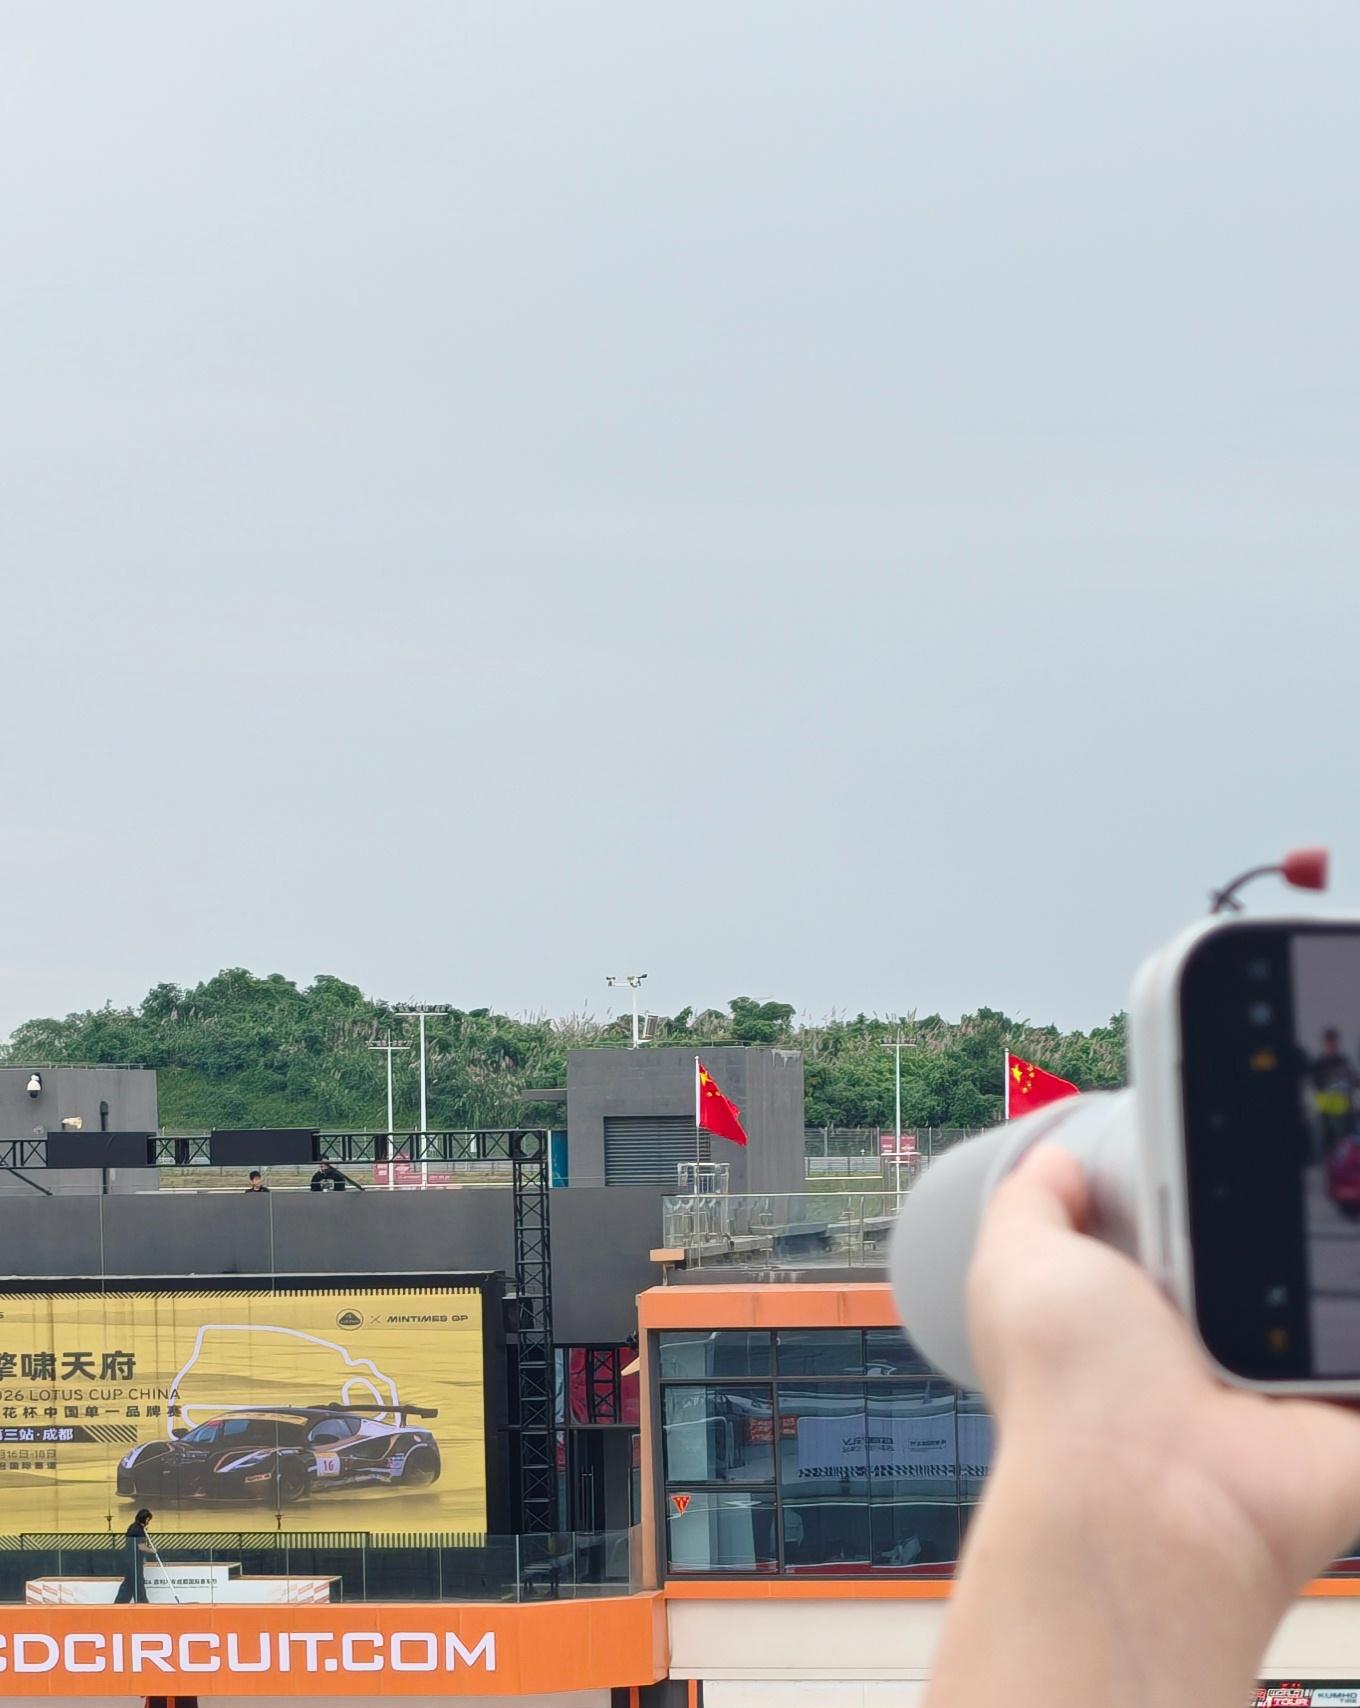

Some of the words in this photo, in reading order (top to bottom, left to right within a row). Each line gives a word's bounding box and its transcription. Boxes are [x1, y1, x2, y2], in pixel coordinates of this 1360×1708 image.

[387, 1315, 448, 1323] MINTIMES
[451, 1315, 469, 1323] GP
[29, 1389, 86, 1401] LOTUS
[89, 1389, 124, 1400] CUP
[128, 1388, 181, 1400] CHINA
[1273, 1697, 1310, 1707] TOUR
